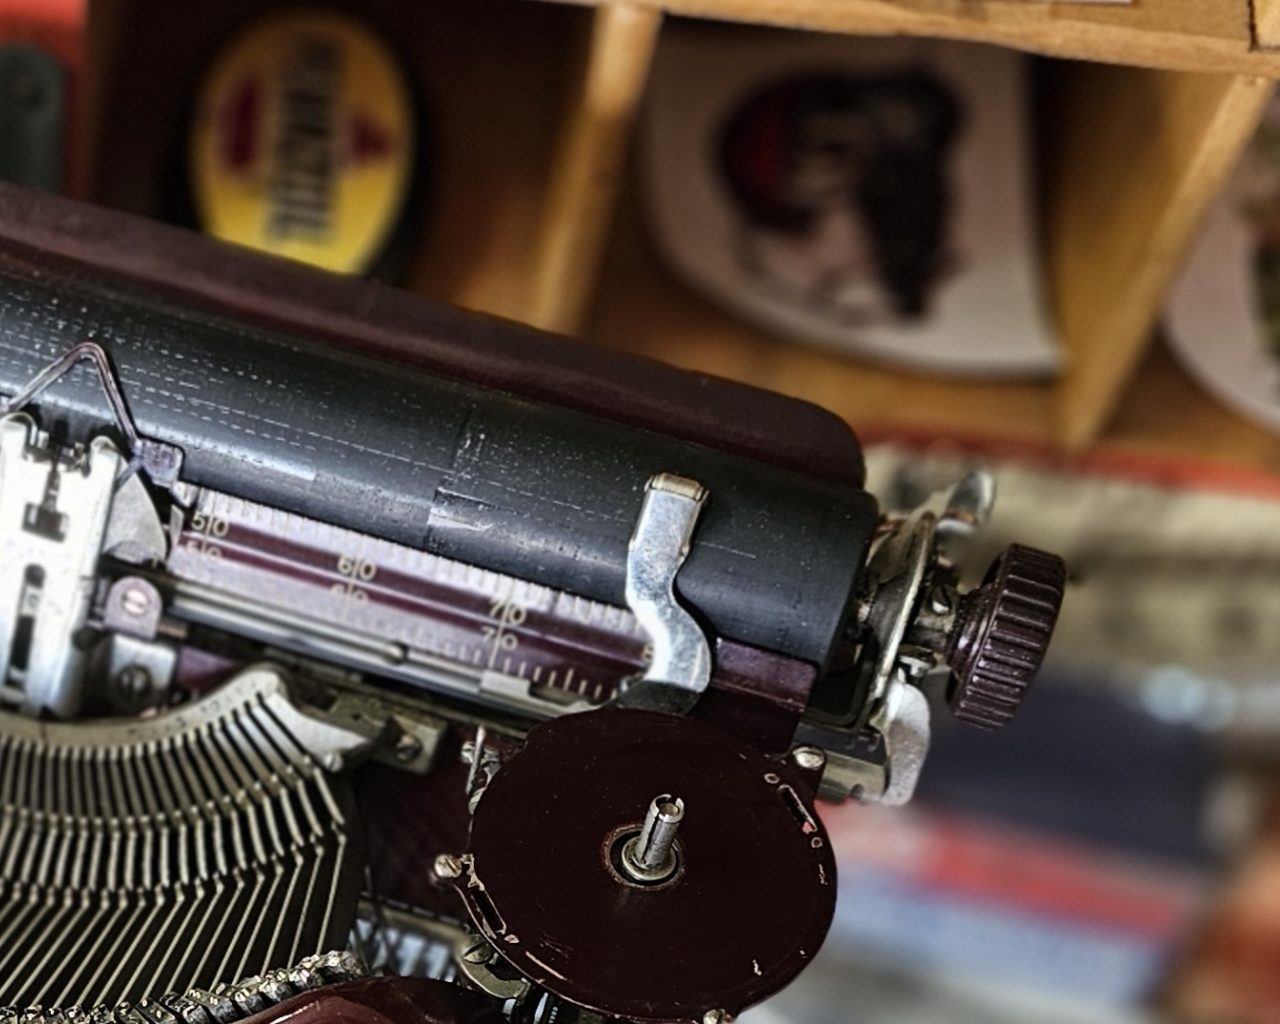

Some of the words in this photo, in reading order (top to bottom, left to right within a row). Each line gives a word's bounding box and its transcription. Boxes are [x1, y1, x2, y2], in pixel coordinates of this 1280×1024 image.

[191, 512, 230, 538] 50
[337, 554, 378, 580] 60
[481, 627, 518, 651] 70
